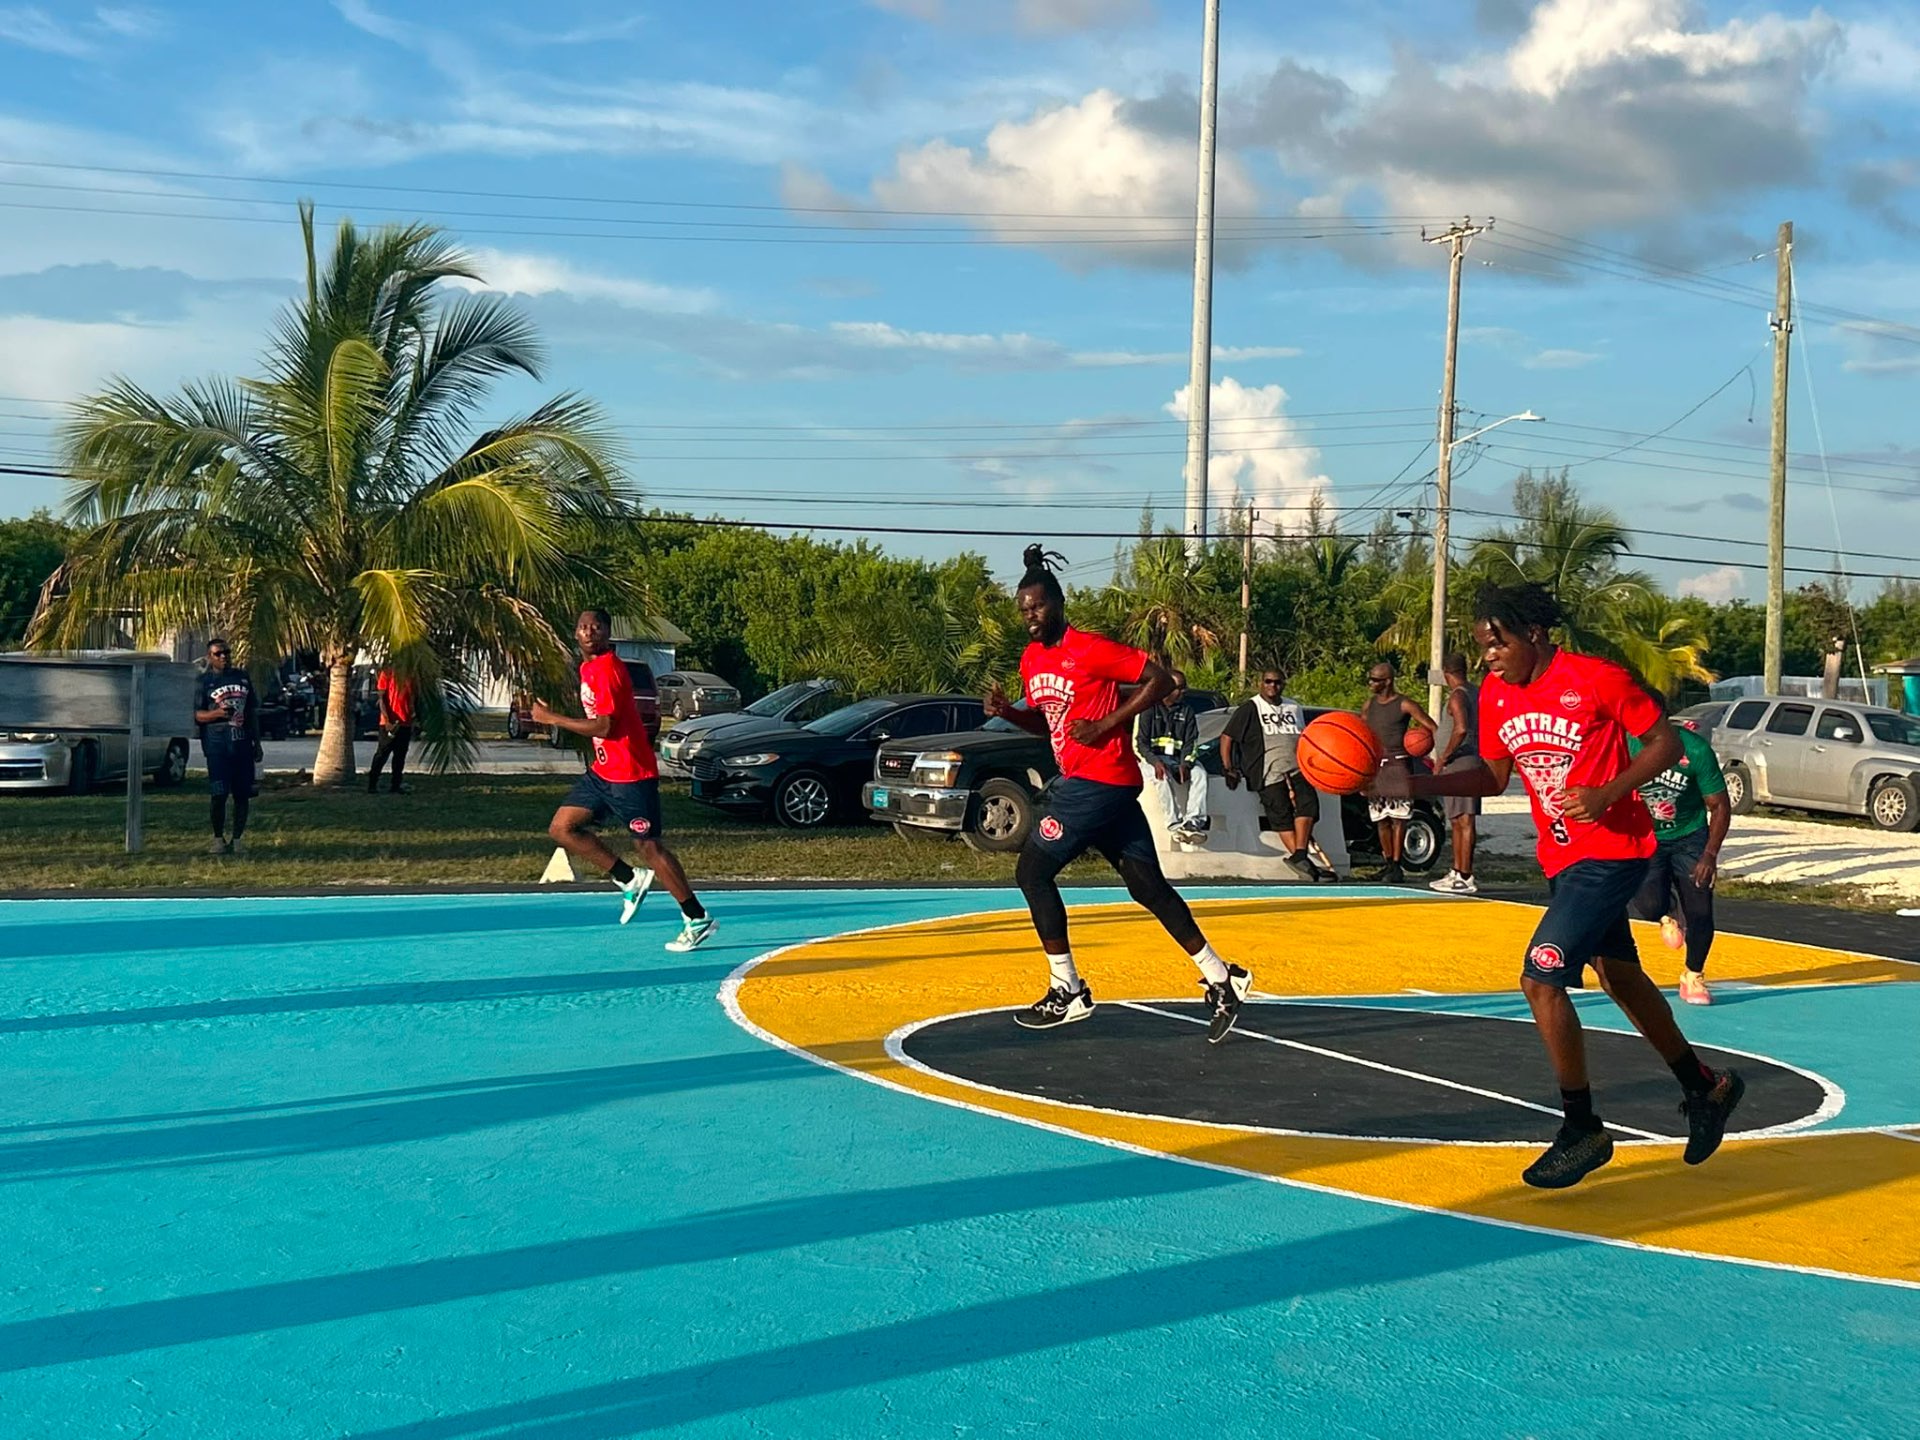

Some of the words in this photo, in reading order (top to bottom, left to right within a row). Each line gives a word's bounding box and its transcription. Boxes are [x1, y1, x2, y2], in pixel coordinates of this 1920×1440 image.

[210, 684, 249, 700] CENTRA
[1498, 712, 1583, 746] CENTRAL
[1532, 732, 1582, 752] BAHAMA
